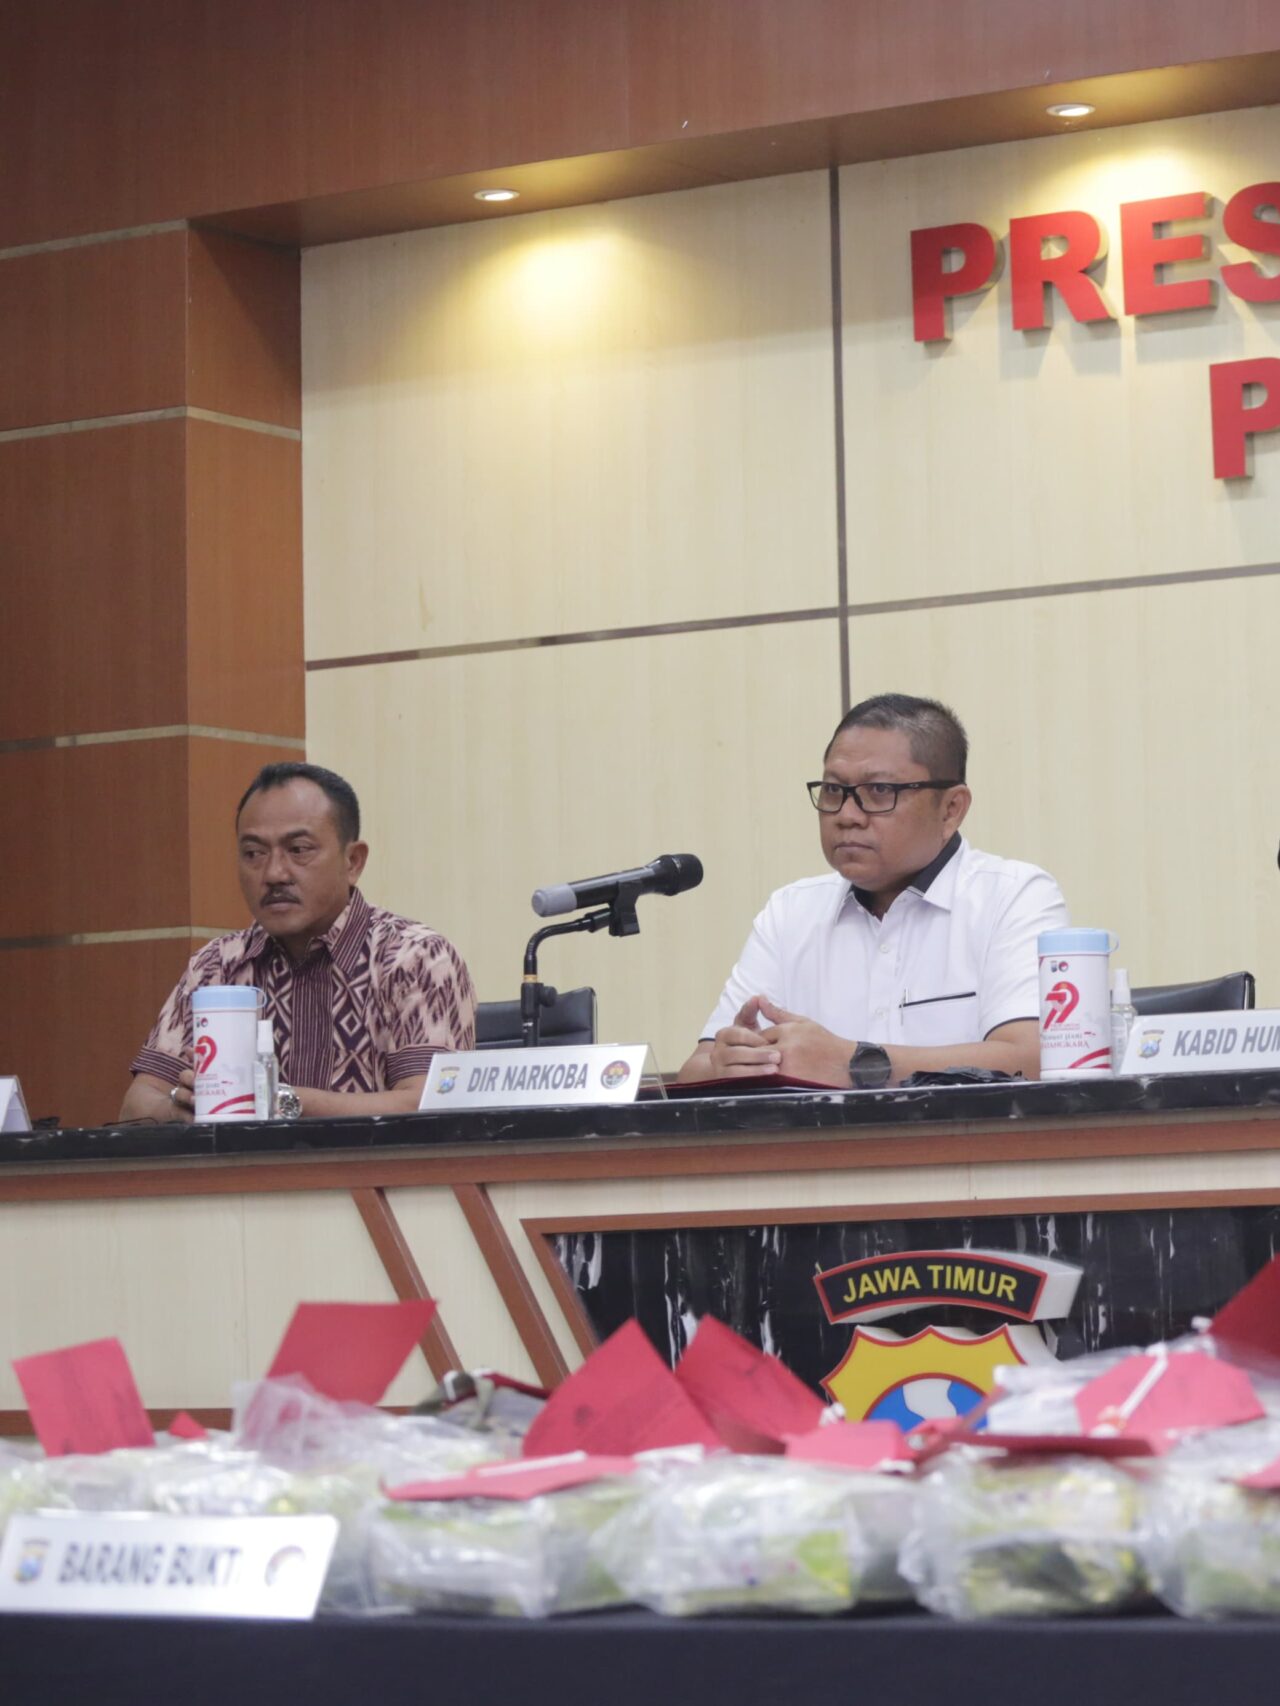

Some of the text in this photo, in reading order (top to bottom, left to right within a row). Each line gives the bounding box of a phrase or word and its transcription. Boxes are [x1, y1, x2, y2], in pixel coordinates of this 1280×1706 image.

[1173, 1028, 1238, 1056] KABID
[467, 1063, 589, 1092] DIR NARKOBA
[843, 1264, 1018, 1303] JAWA TIMUR
[58, 1541, 243, 1586] BARANG BUKT
